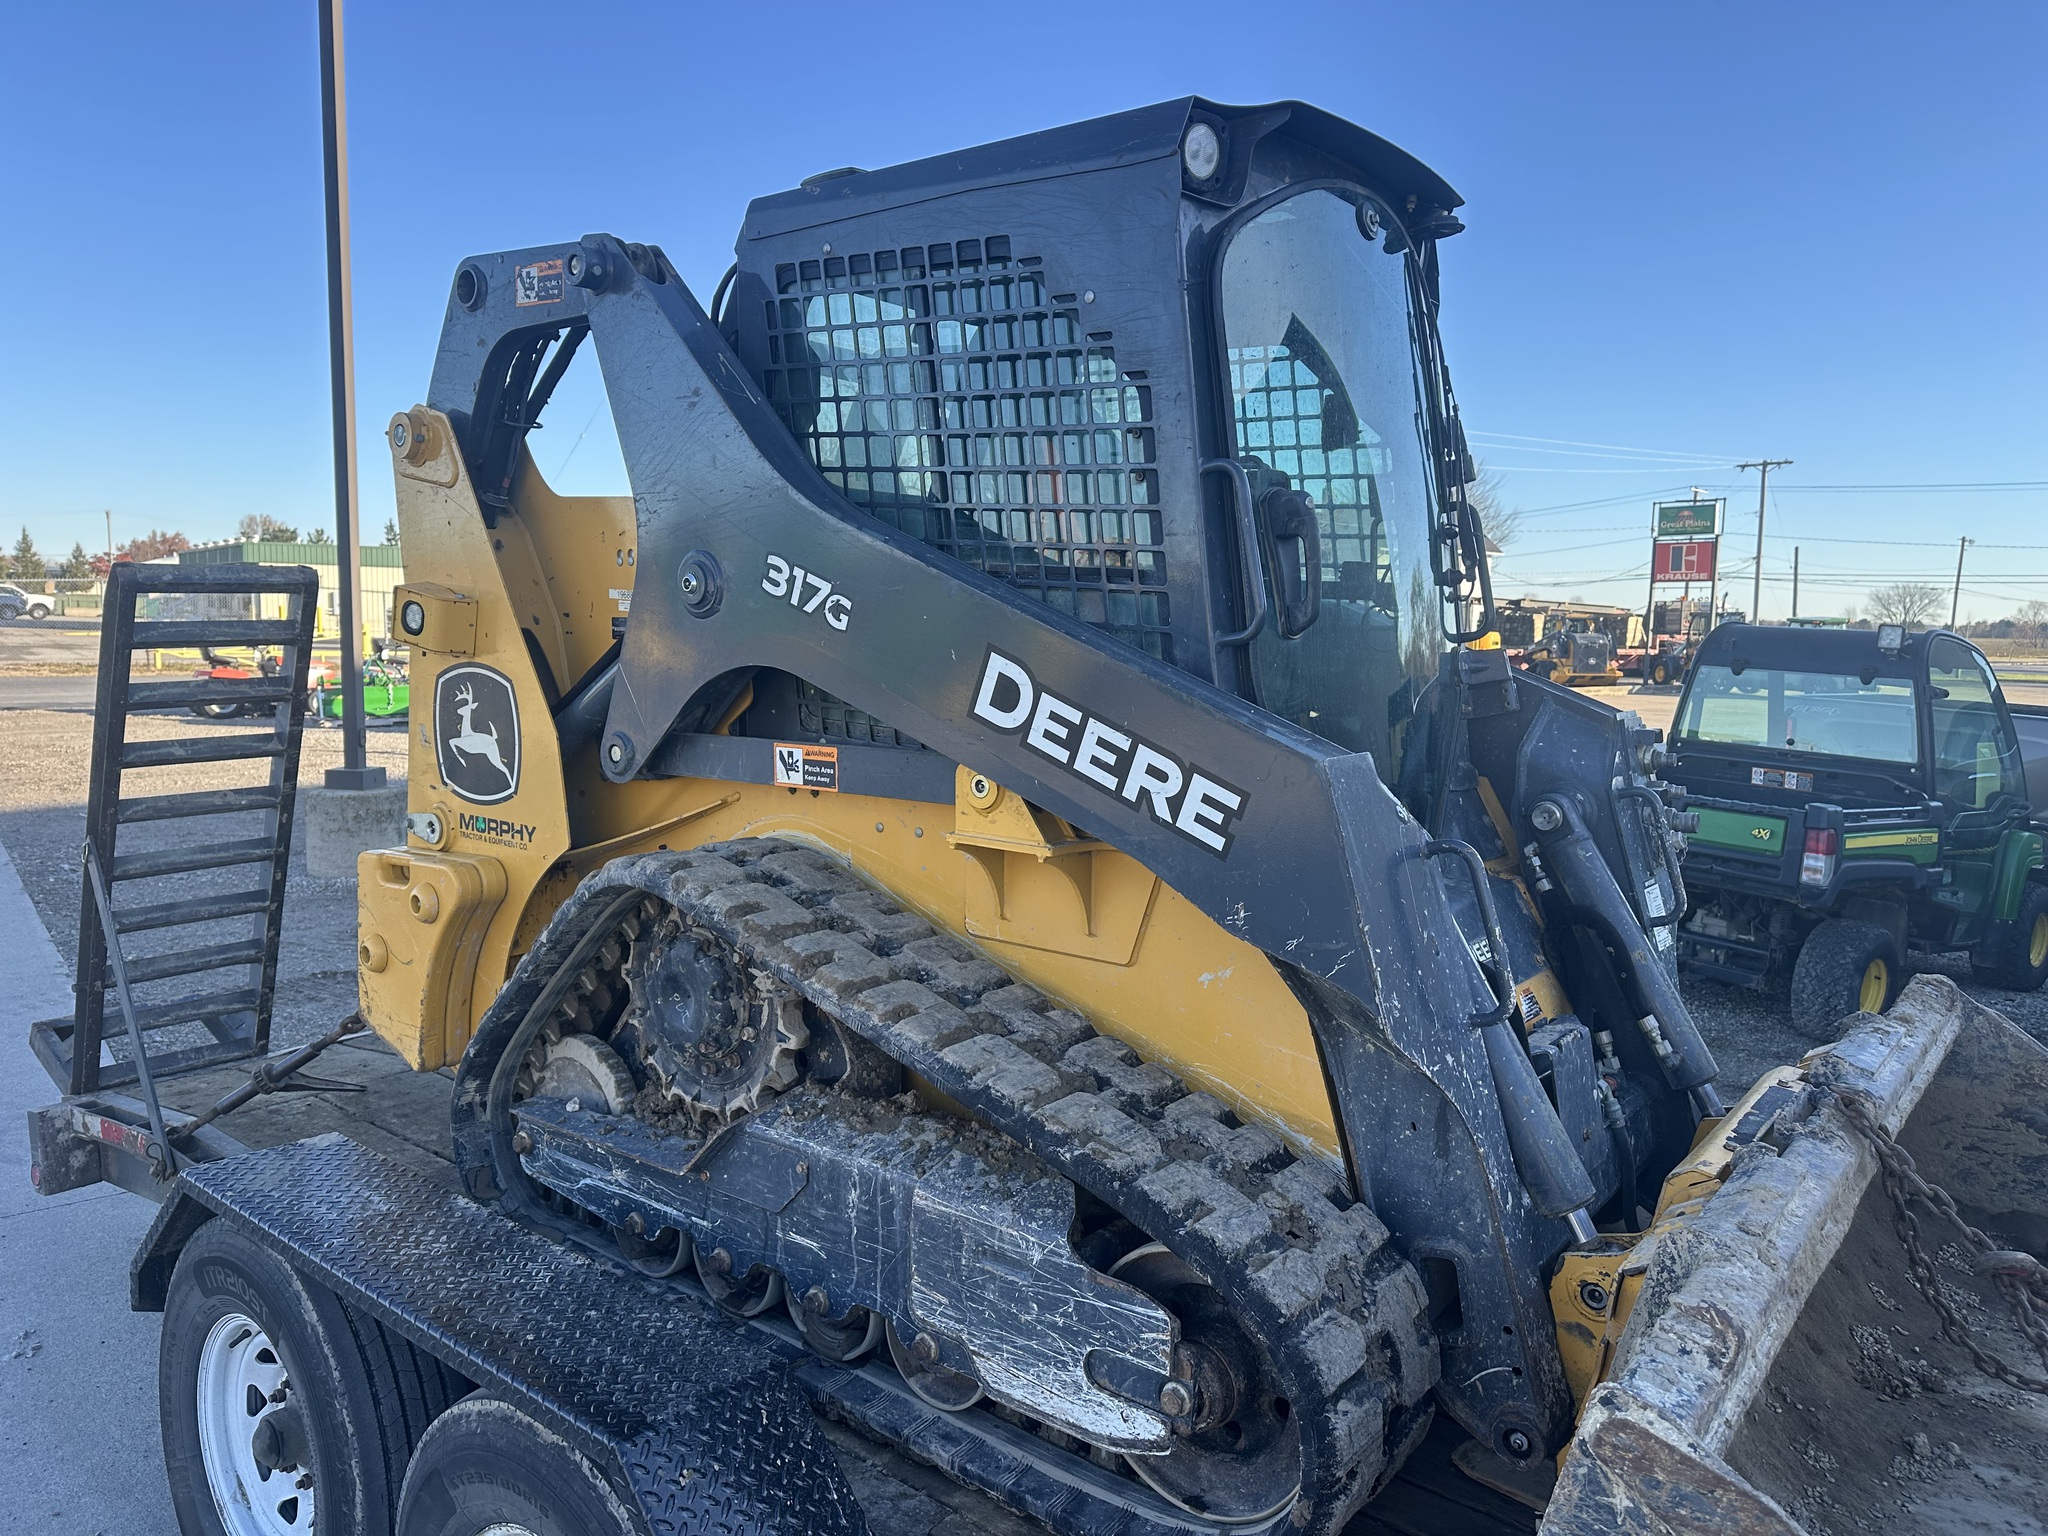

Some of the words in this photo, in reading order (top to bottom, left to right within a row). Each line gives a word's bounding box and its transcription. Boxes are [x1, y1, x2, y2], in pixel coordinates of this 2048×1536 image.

[1660, 520, 1685, 528] Great
[1685, 519, 1711, 527] Plains
[1656, 573, 1708, 581] KRAUSE
[761, 554, 852, 631] 317G
[810, 750, 834, 758] WARNING
[973, 651, 1242, 852] DEERE
[805, 764, 820, 773] Pinch
[821, 766, 834, 774] Area
[805, 774, 817, 782] Keep
[817, 775, 830, 783] Away
[459, 812, 537, 843] MURPHY
[459, 830, 483, 842] TRACTOR
[483, 835, 488, 843] &
[488, 836, 518, 849] EQUIPMENT
[1904, 834, 1918, 845] JOHN
[1917, 833, 1933, 845] DEERE
